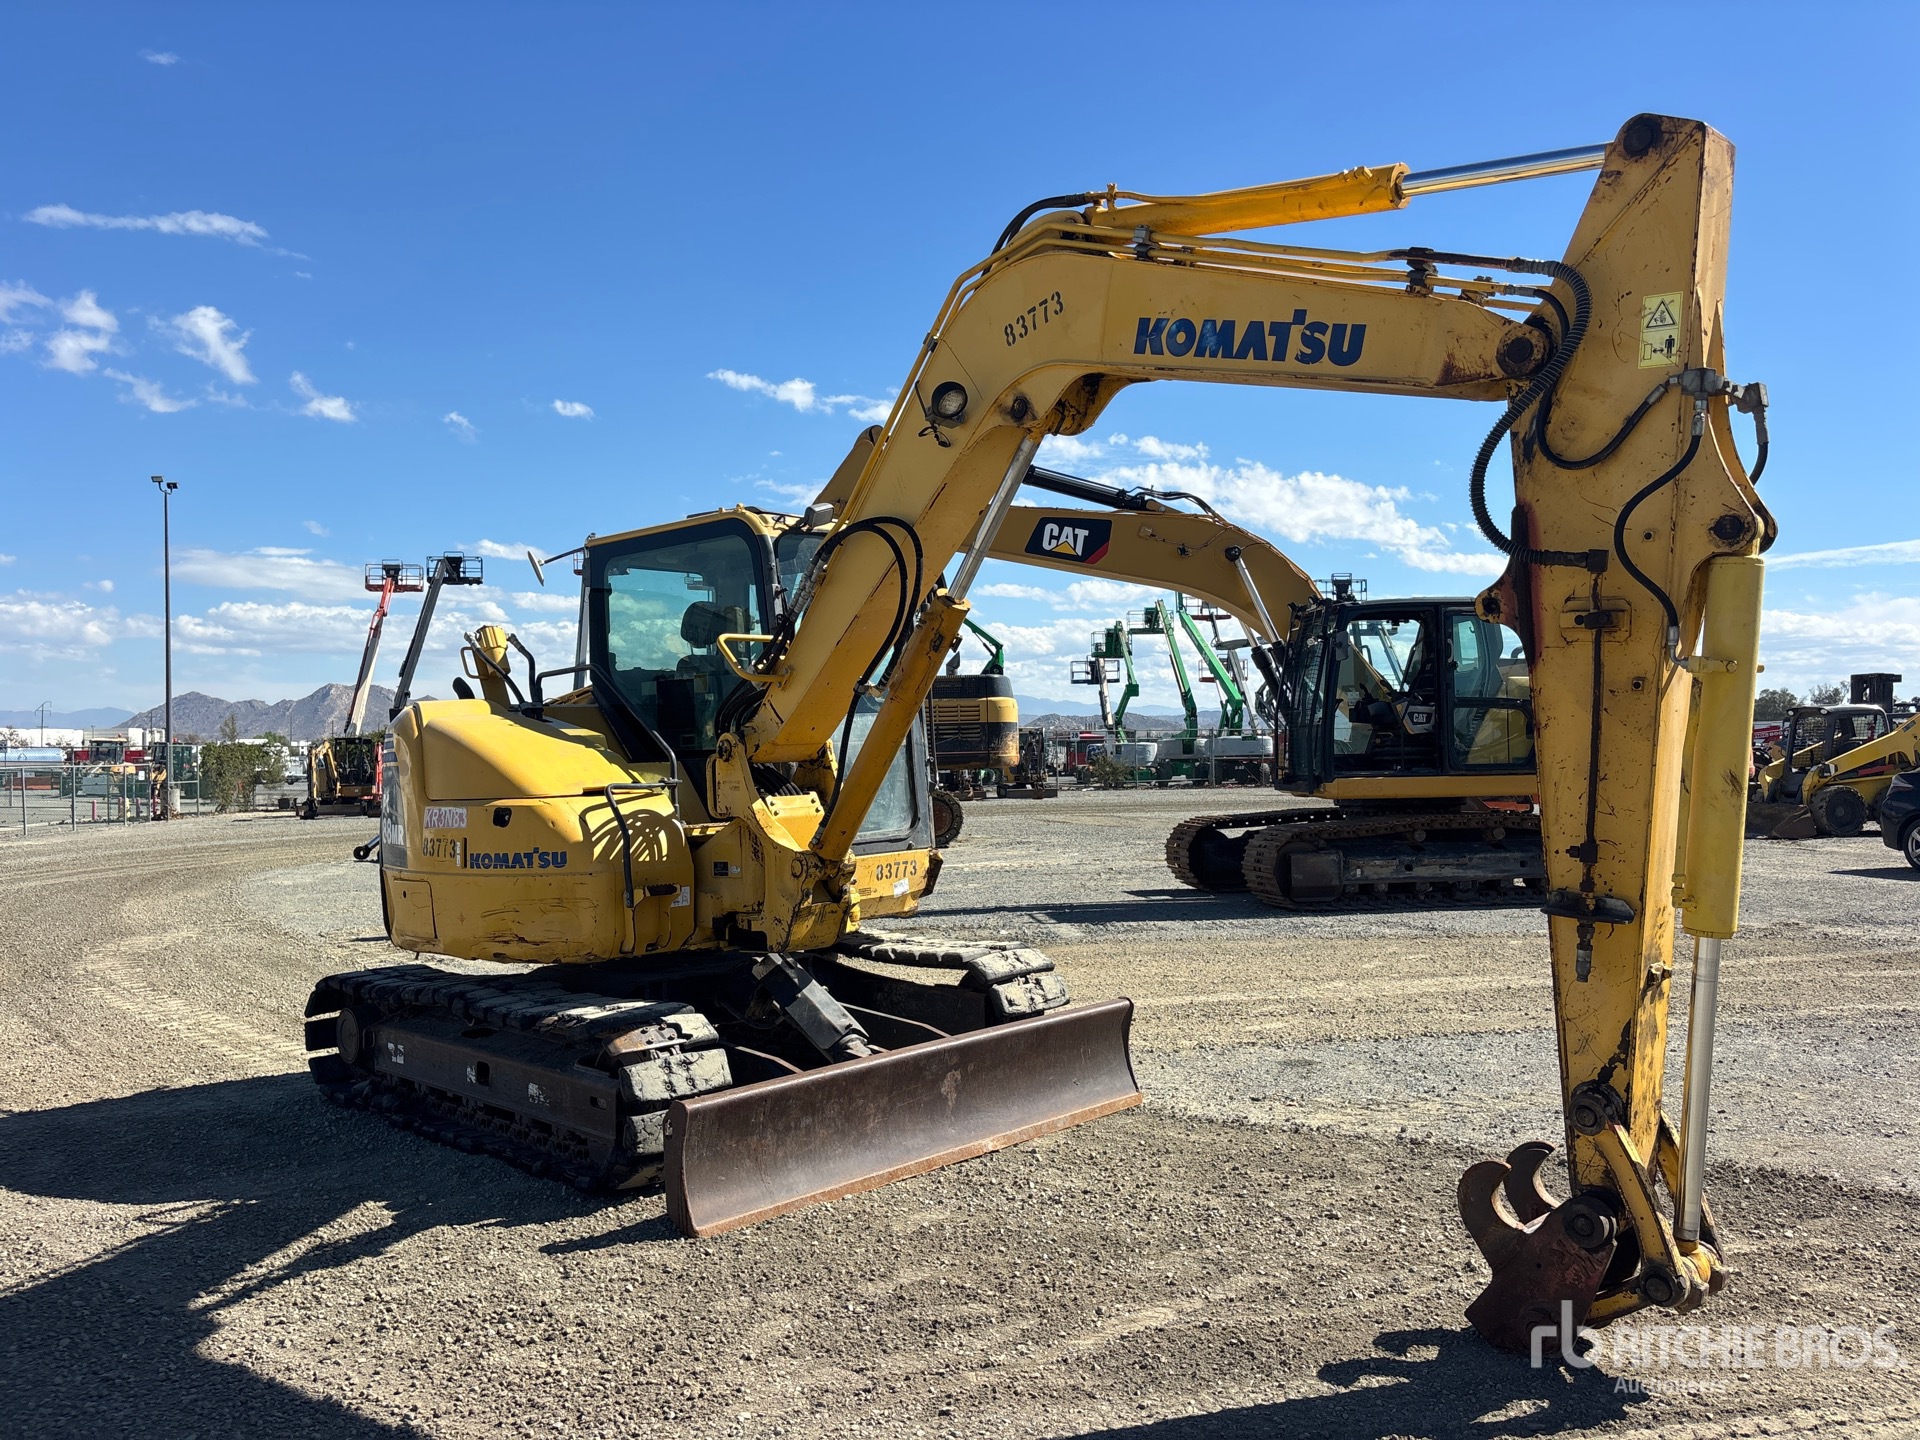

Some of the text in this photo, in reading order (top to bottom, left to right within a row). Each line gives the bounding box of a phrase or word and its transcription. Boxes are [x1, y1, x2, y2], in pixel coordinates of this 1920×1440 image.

[1003, 291, 1065, 347] 83773
[1133, 308, 1367, 367] KOMATSU
[1042, 523, 1089, 556] CAT
[1413, 713, 1427, 723] CAT
[422, 837, 456, 859] 83773
[469, 847, 567, 870] KOMATSU
[876, 859, 917, 881] 83773
